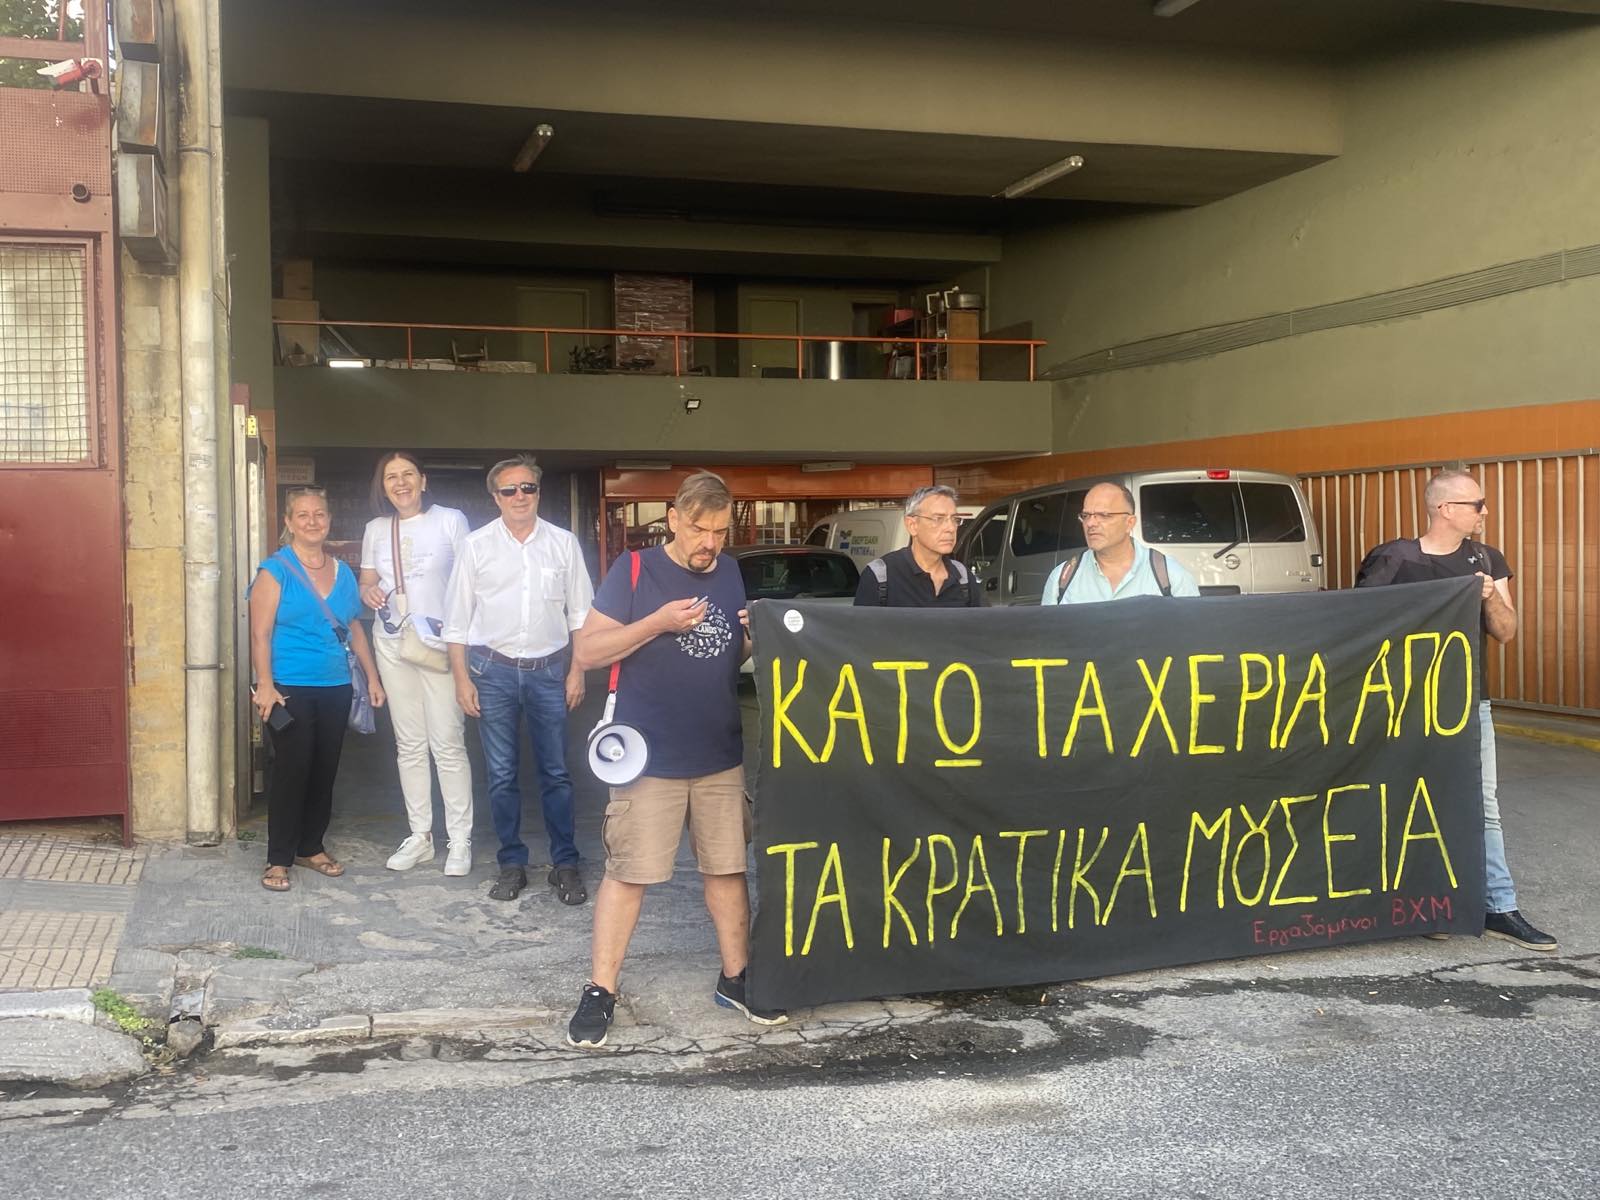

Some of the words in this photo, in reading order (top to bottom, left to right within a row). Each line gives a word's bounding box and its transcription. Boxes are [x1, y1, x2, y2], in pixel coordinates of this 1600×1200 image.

[771, 657, 983, 769] ΚΑΤΩ
[1010, 657, 1114, 758] ΤΑ
[1128, 651, 1330, 759] ΧΕΡΙΑ
[1348, 630, 1474, 747] ΑΠΟ
[765, 840, 855, 957] ΤΑ
[881, 821, 1158, 949] ΚΡΑΤΙΚΑ
[1391, 895, 1454, 926] ΒΧΜ
